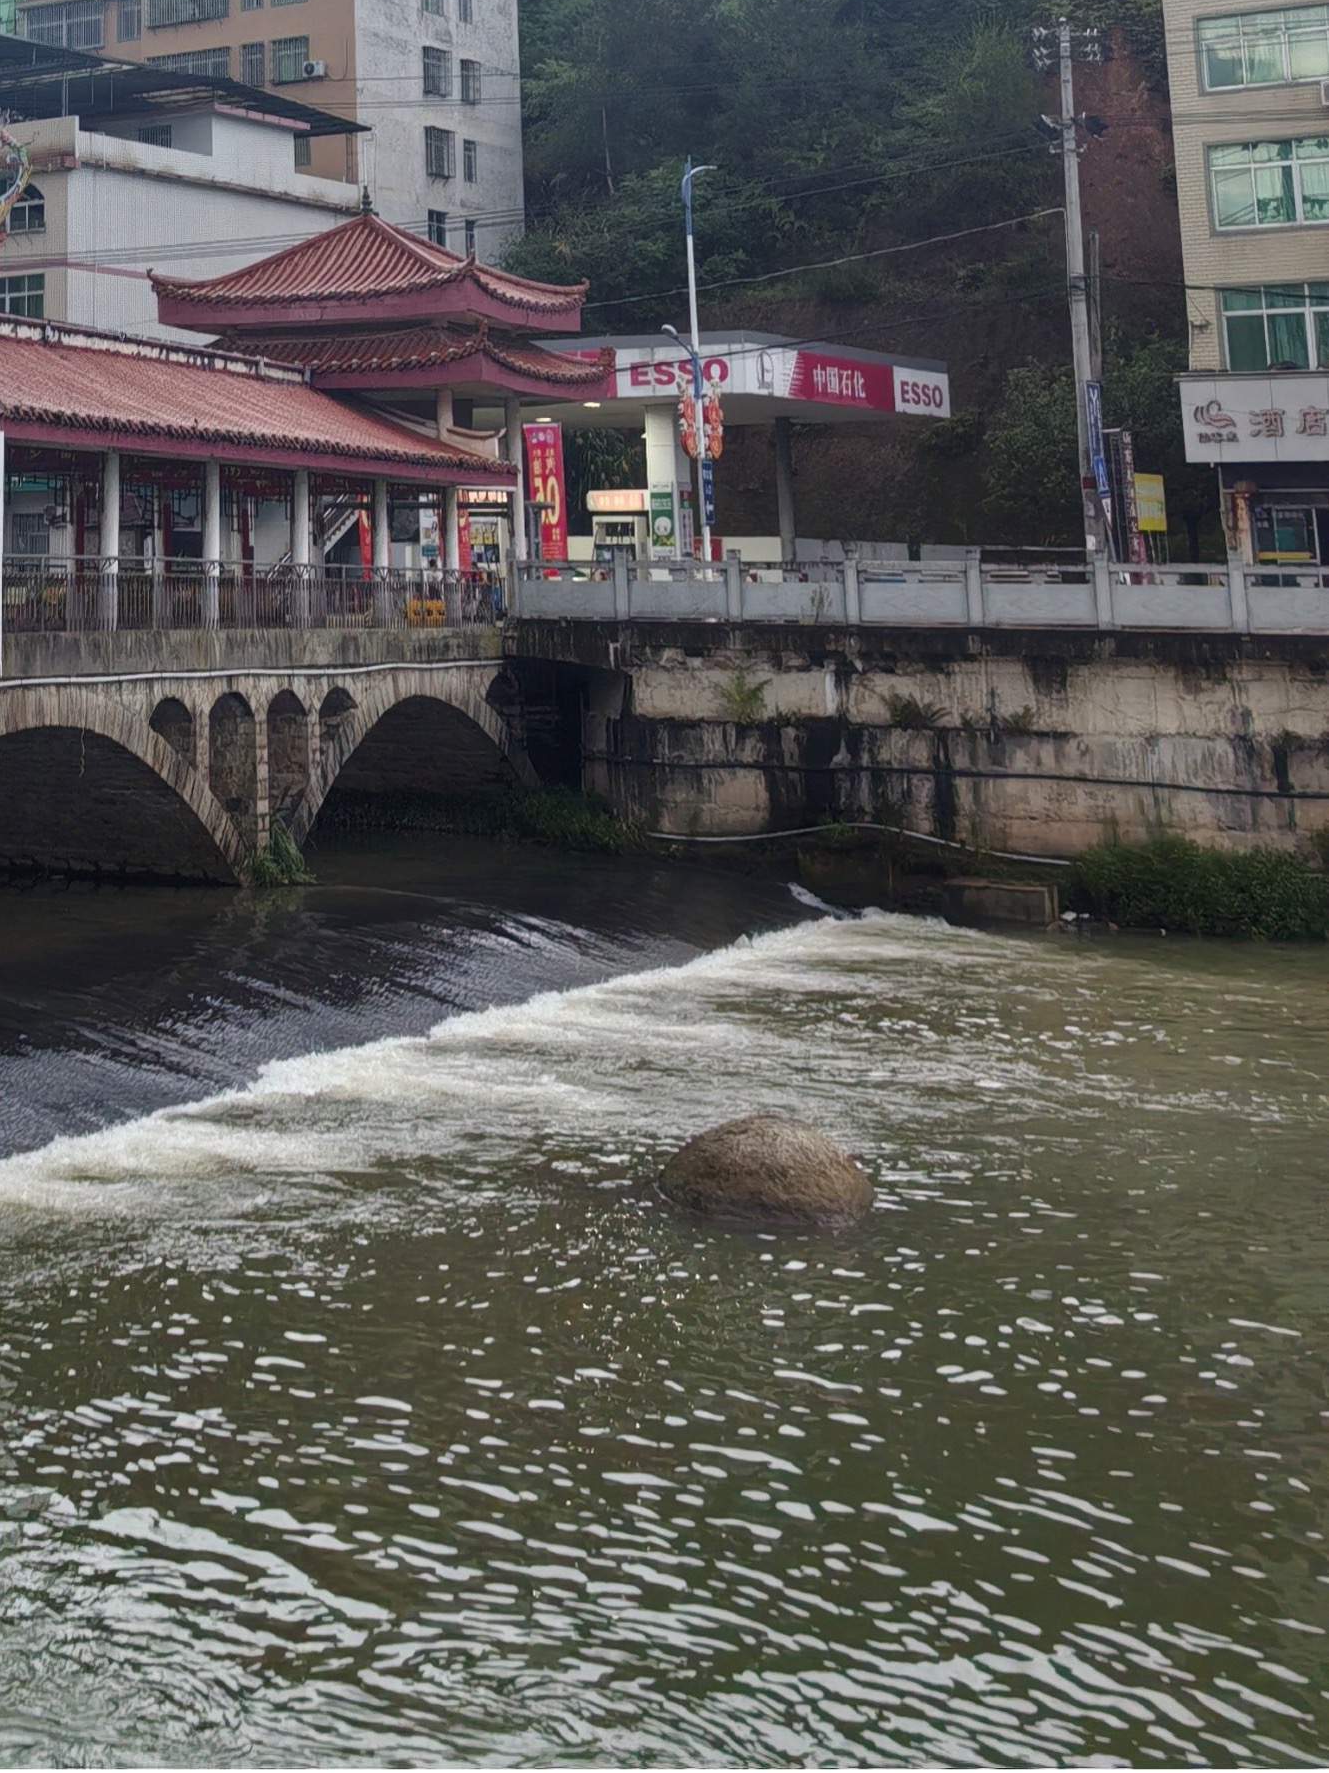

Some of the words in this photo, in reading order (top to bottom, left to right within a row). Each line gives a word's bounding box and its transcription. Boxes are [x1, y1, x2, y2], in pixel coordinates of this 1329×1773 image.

[630, 358, 728, 386] ESSO
[813, 364, 866, 398] 中国石化
[900, 380, 943, 408] ESSO
[1249, 405, 1329, 438] 酒店
